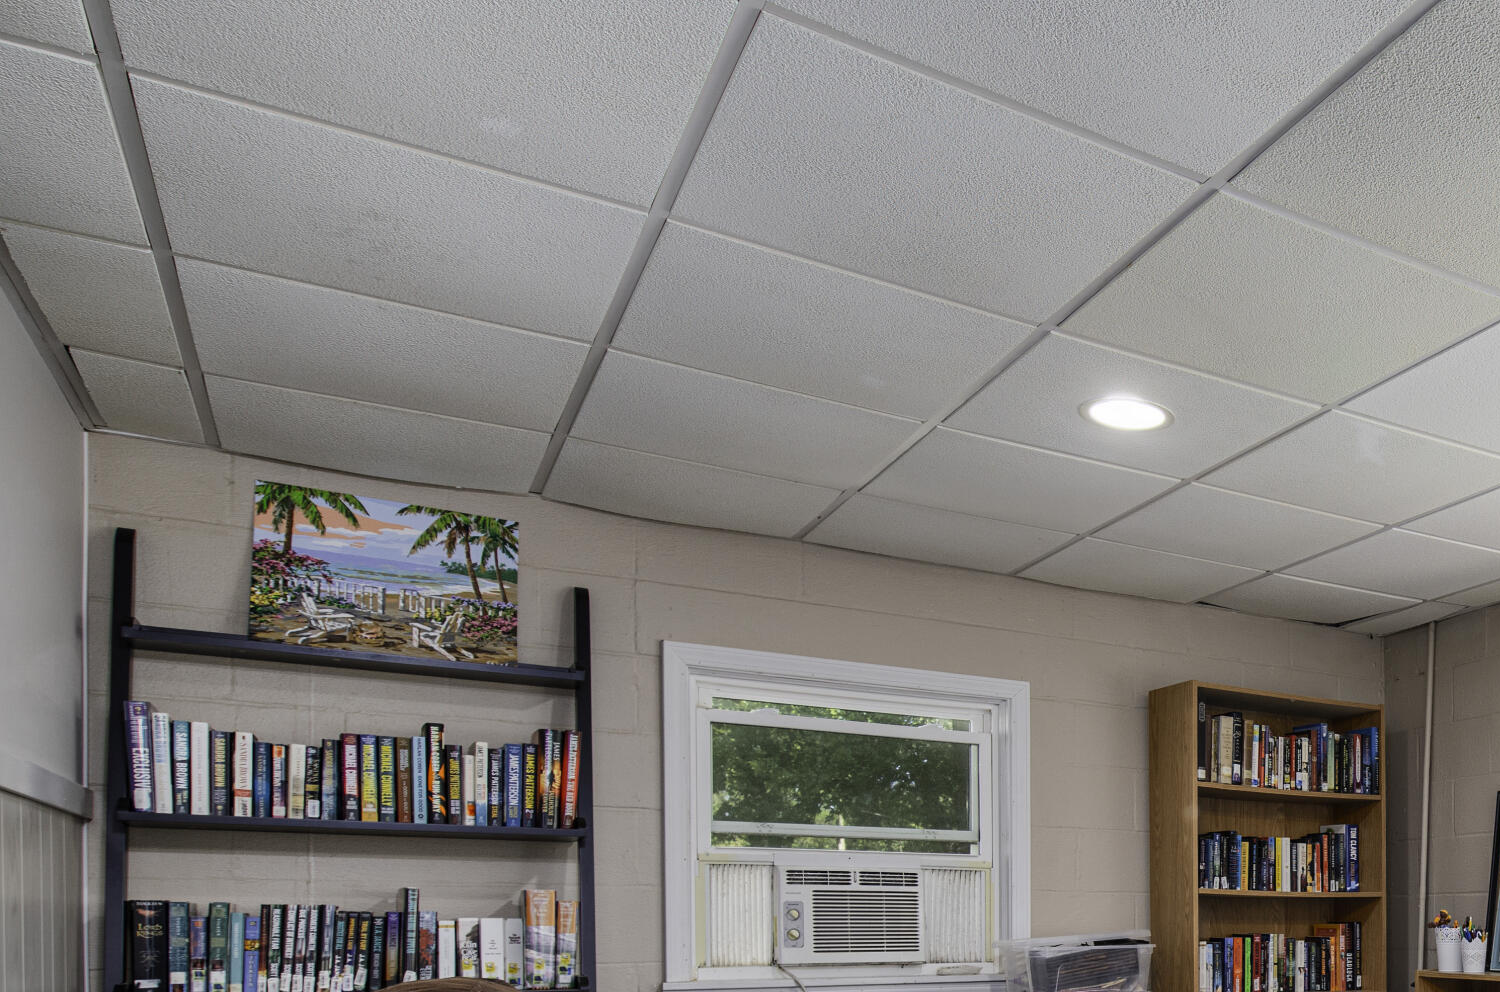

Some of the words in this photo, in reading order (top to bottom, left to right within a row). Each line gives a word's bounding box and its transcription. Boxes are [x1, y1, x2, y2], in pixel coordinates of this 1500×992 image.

[176, 733, 188, 760] SANDRA
[214, 738, 226, 762] SANDRA
[430, 726, 439, 751] HARLAN
[345, 744, 357, 768] MICHAEL
[363, 744, 375, 770] MICHAEL
[381, 746, 392, 772] MICHAEL
[449, 758, 459, 774] JAMES
[509, 754, 519, 773] JAMES
[526, 754, 534, 773] JAMES
[176, 763, 188, 789] BROWN
[214, 764, 225, 787] BROWN
[345, 770, 359, 796] CONNELLY
[363, 771, 376, 801] CONNELLY
[449, 774, 460, 799] PATTERSON
[381, 775, 393, 807] CONNELLY
[509, 773, 519, 806] PATTERSON
[525, 774, 534, 809] PATTERSON
[373, 936, 381, 952] JANCE
